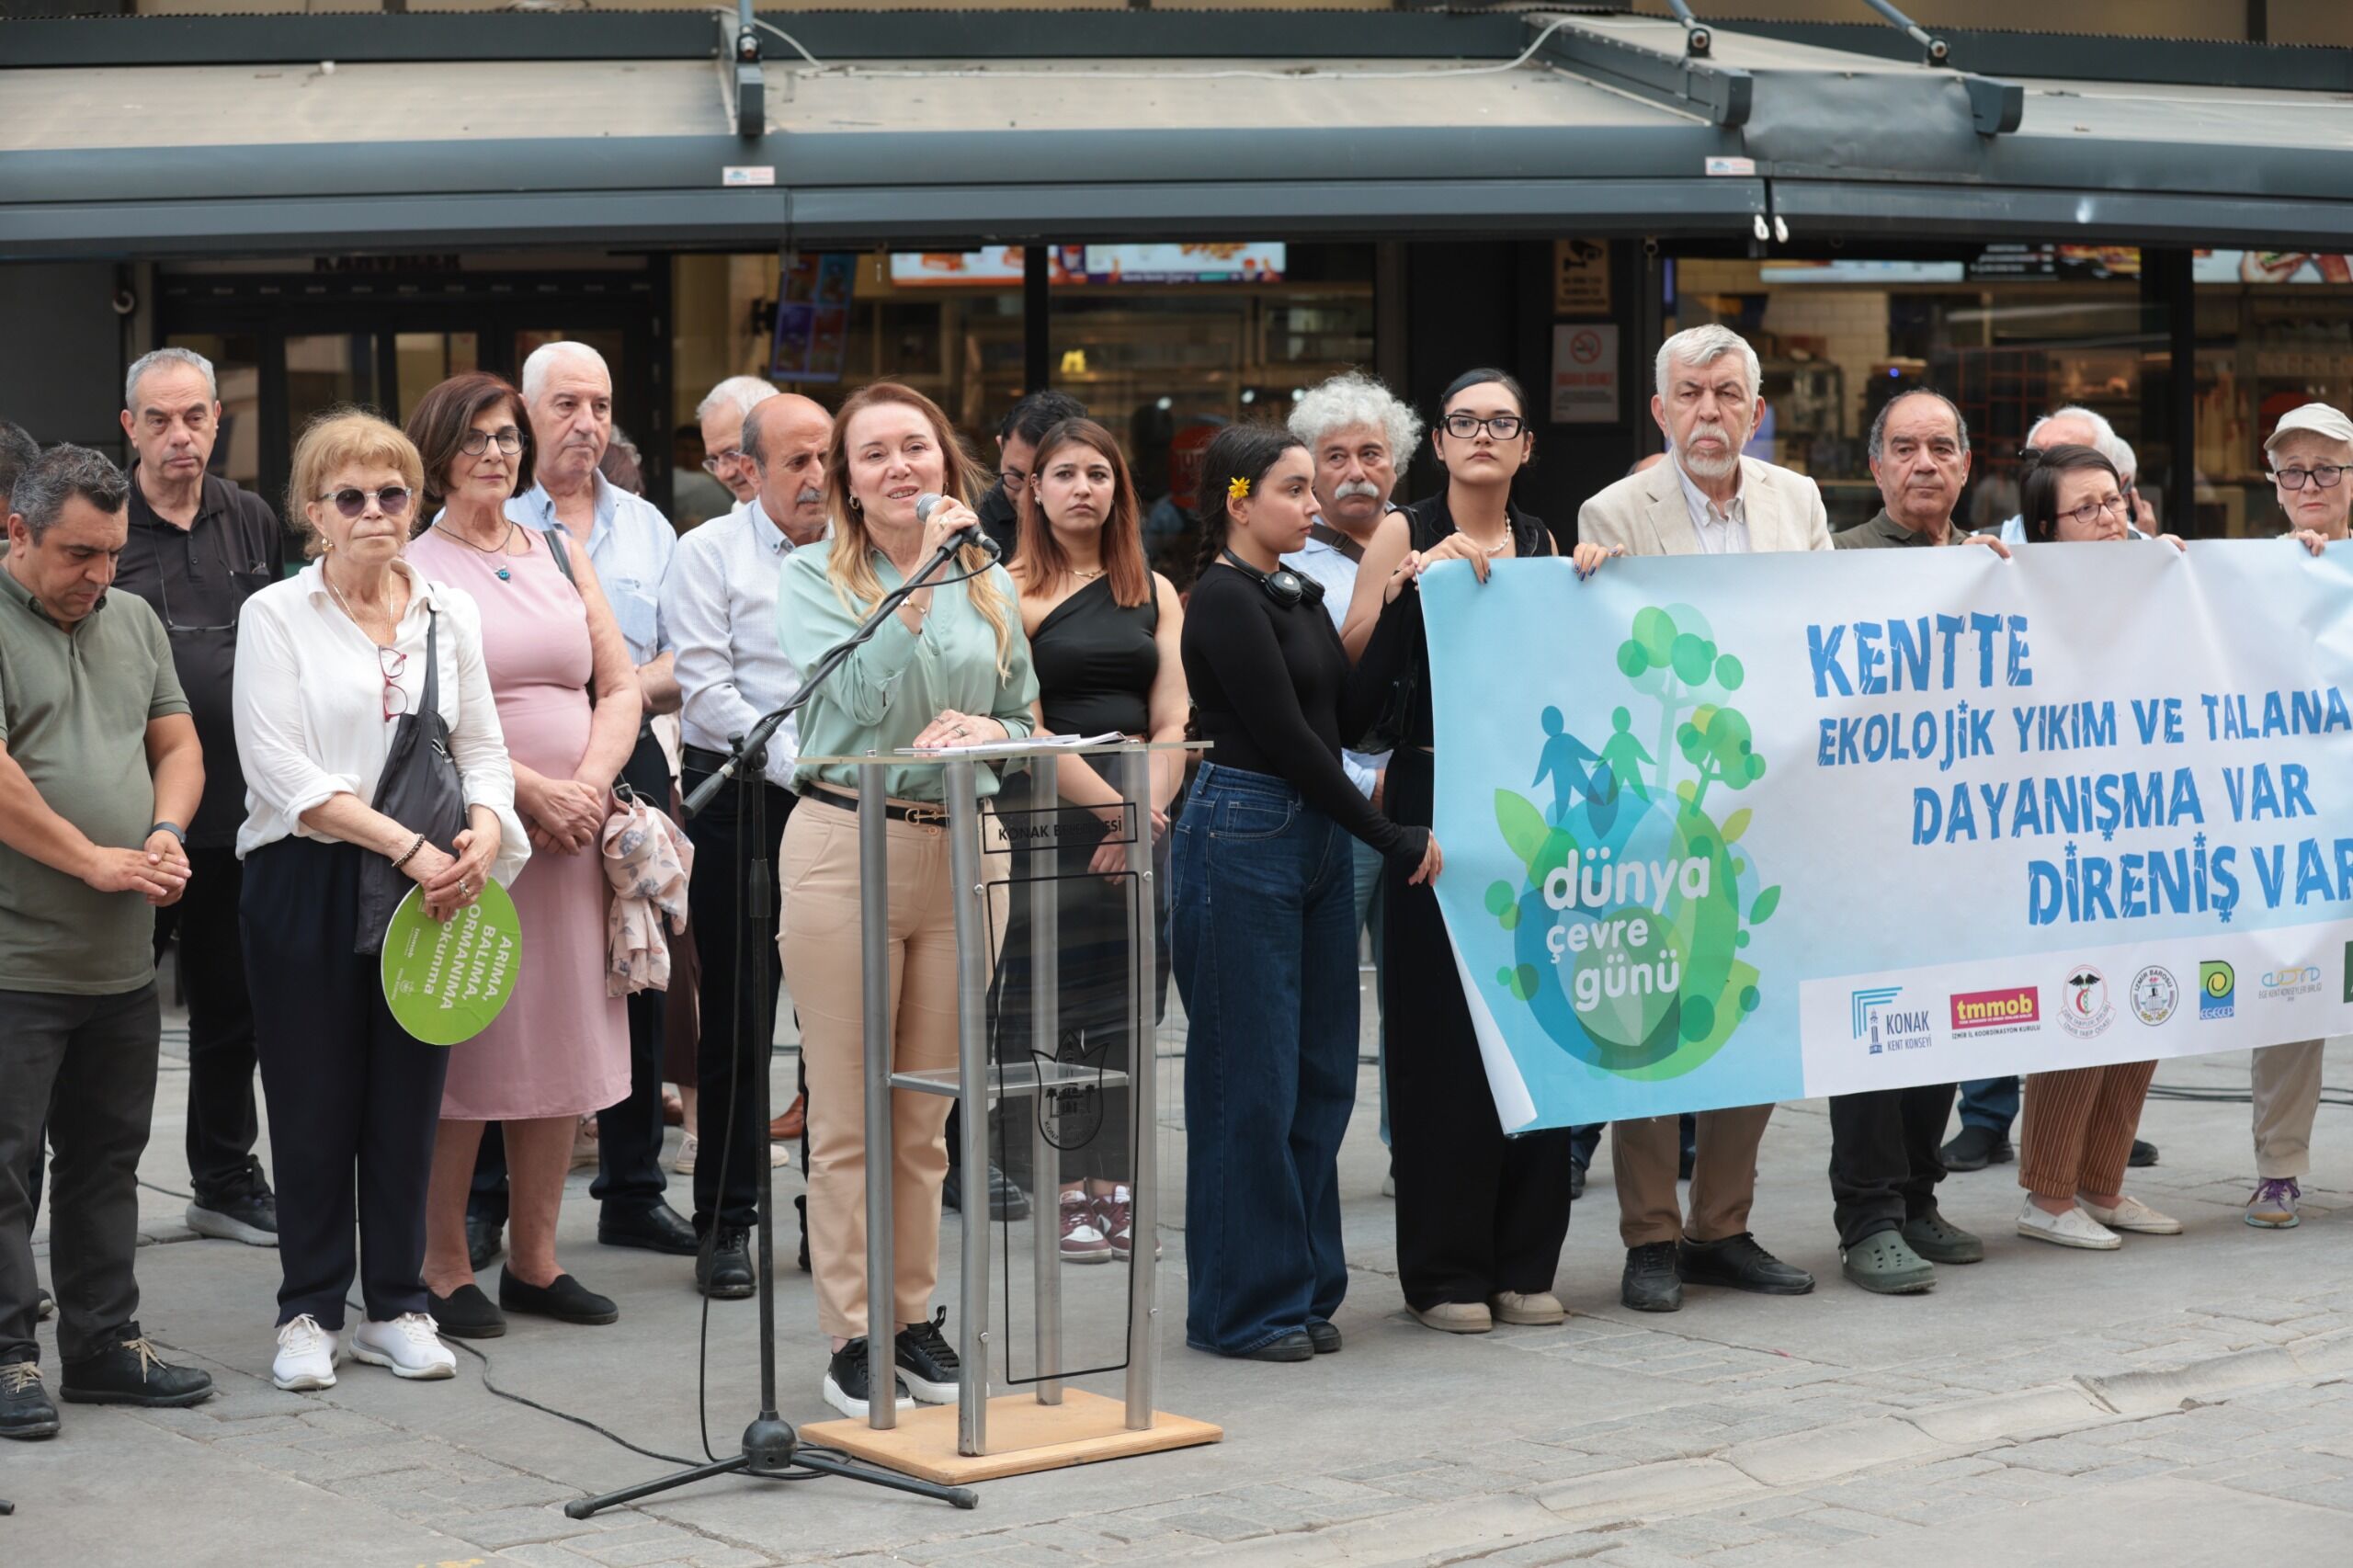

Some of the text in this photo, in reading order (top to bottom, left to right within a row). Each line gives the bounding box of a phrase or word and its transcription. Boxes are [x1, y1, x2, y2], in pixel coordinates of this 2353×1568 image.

[1806, 611, 2033, 698] KENTTE
[1817, 686, 2353, 772] EKOLOJİK YIKIM VE TALANA
[999, 824, 1049, 841] KONAK
[1912, 762, 2317, 846] DAYANIŞMA VAR
[1543, 846, 1711, 915] dünya
[2028, 832, 2240, 926] DİRENİŞ
[439, 903, 482, 1009] ORMANIMA
[461, 925, 496, 1001] BALIMA,
[482, 936, 513, 1002] ARIMA,
[1546, 918, 1648, 964] çevre
[1575, 949, 1679, 1012] günü
[1957, 994, 2033, 1020] tmmob
[2149, 970, 2173, 988] BAROSU
[1886, 1010, 1929, 1036] KONAK
[1887, 1035, 1932, 1052] KENT KONSEYİ
[1974, 1027, 2018, 1037] KOORDİNASYON
